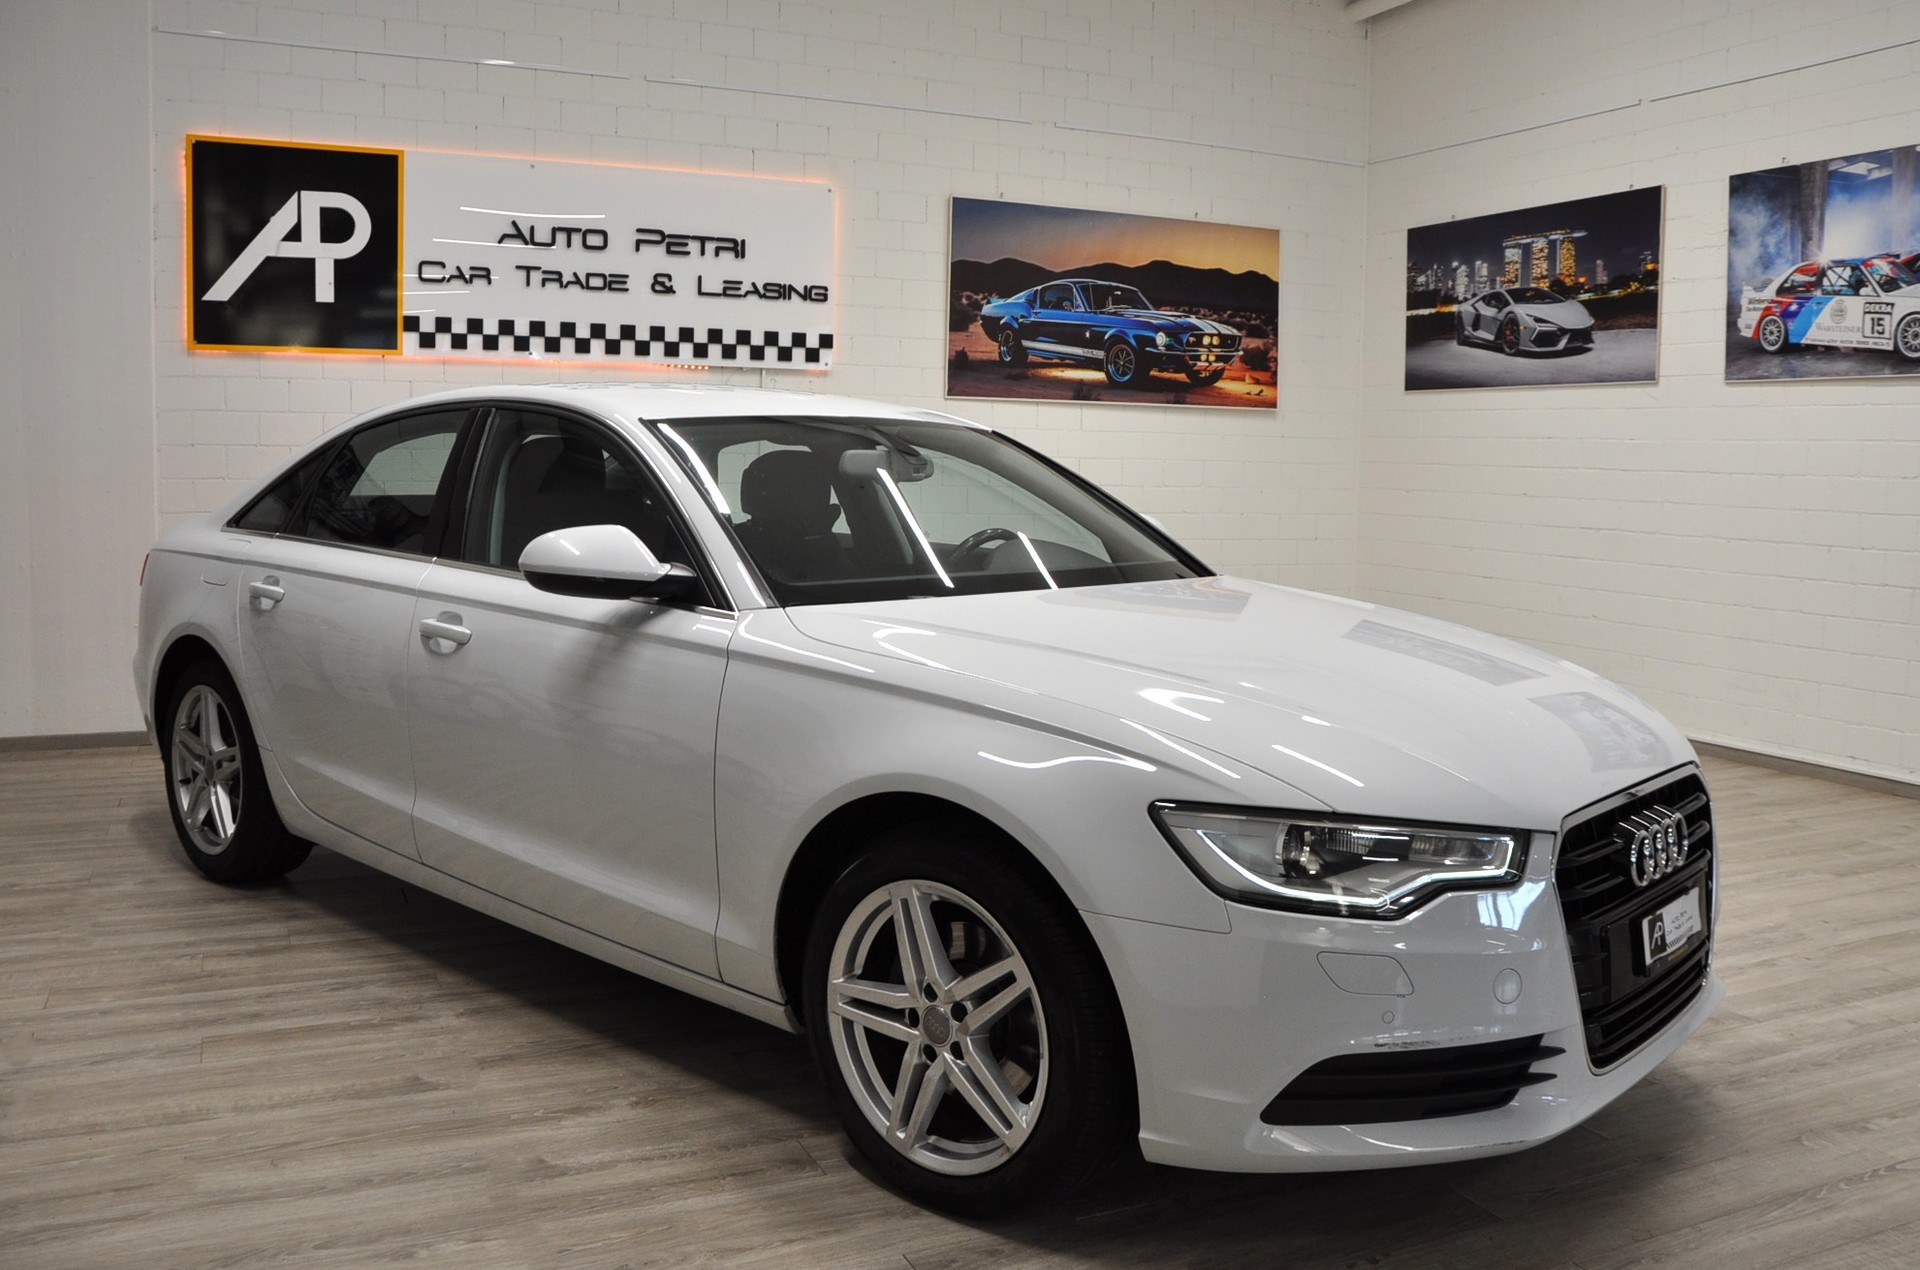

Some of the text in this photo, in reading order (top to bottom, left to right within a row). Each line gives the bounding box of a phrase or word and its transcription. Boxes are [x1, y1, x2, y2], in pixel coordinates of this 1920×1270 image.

[202, 190, 372, 302] AP
[498, 219, 746, 259] AUTO PETRI
[418, 260, 829, 302] CAR TRADE & LEASING
[1864, 304, 1892, 313] DEKRA
[1871, 317, 1885, 335] 15
